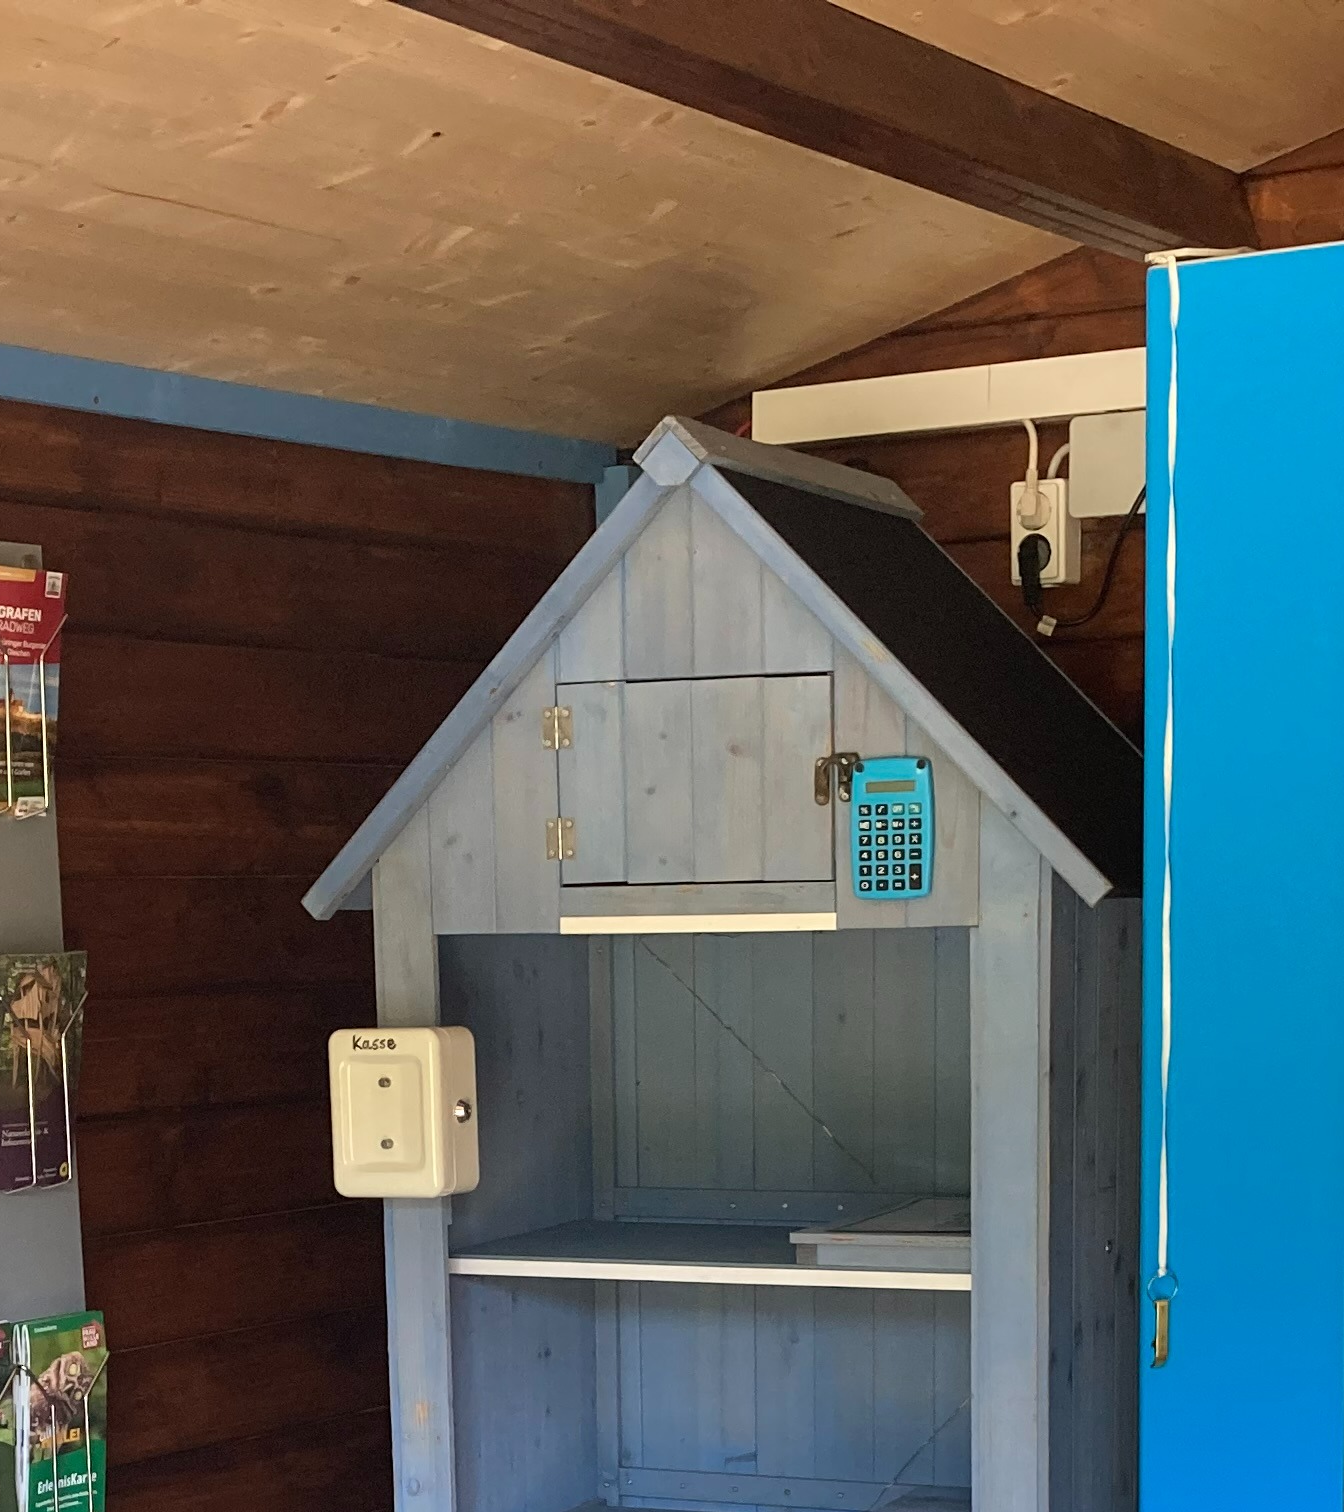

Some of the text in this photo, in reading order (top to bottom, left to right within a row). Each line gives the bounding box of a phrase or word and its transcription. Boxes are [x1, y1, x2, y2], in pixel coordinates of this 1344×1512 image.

[861, 836, 868, 845] 7
[894, 835, 902, 844] 9
[861, 852, 868, 860] 4
[877, 851, 885, 859] 5
[894, 850, 902, 859] 6
[862, 866, 902, 875] 1 2 3
[352, 1034, 397, 1051] Kasse
[37, 1472, 97, 1494] ErlenisKare
